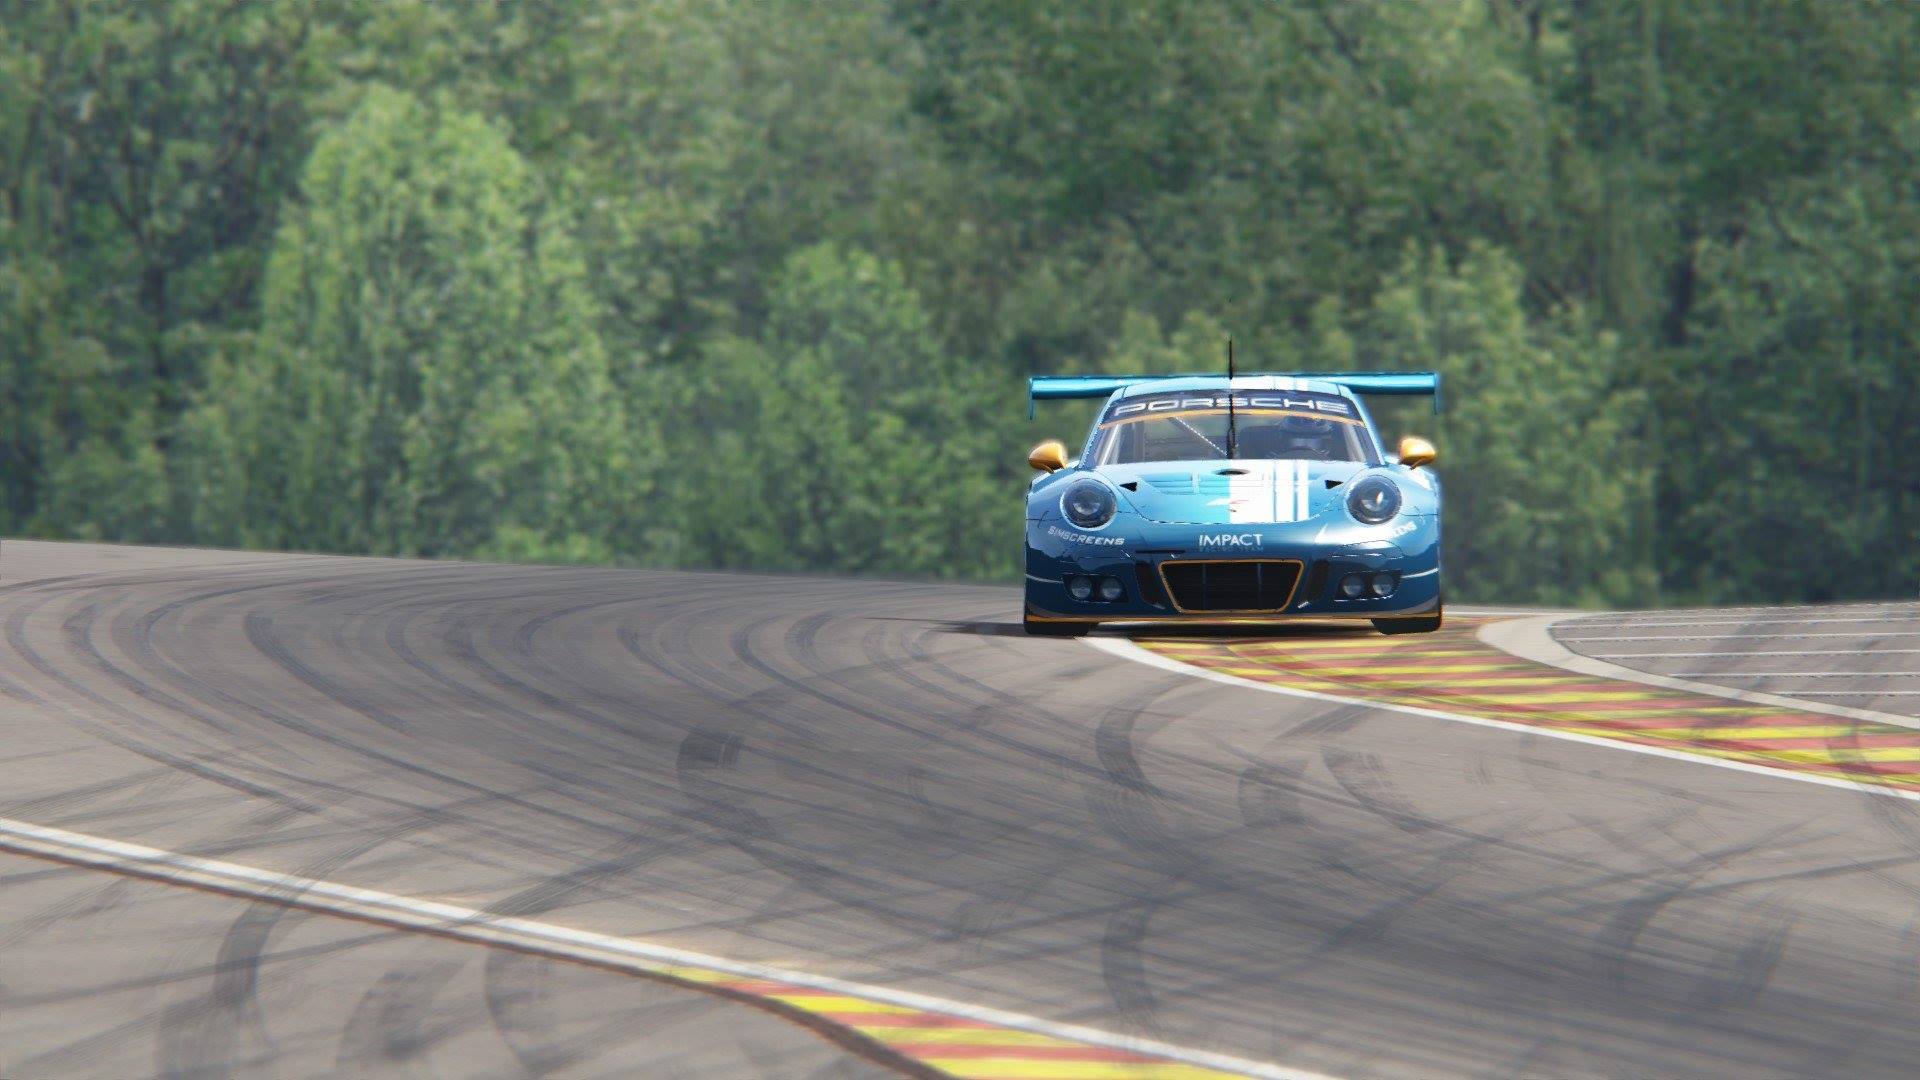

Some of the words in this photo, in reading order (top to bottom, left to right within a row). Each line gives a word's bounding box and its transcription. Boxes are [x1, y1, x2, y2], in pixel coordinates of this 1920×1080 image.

[1114, 397, 1350, 416] PORSCHE
[1047, 525, 1126, 546] SIMSCREENS
[1198, 533, 1264, 547] IMPACT
